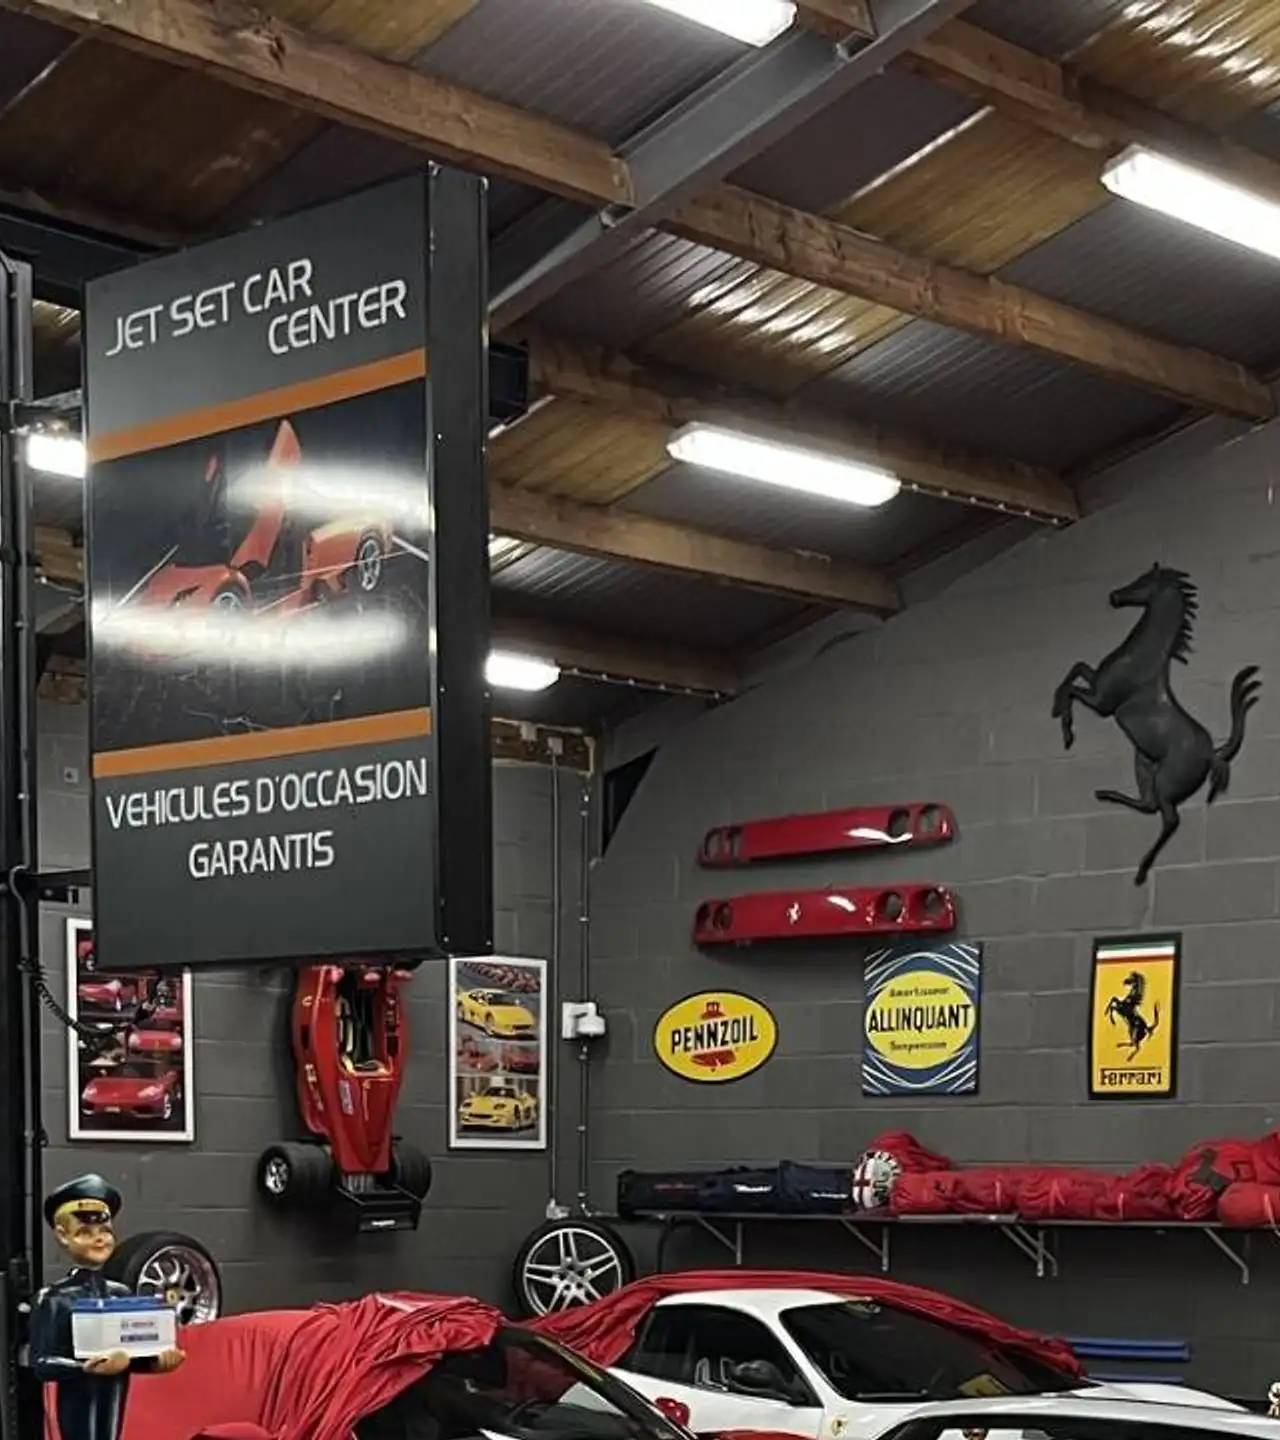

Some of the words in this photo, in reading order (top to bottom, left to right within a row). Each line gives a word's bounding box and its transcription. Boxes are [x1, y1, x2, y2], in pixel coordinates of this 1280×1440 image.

[105, 304, 164, 356] JET
[170, 281, 236, 337] SET
[243, 258, 313, 314] CAR
[267, 280, 407, 354] CENTER
[105, 779, 251, 829] VEHICULES
[256, 758, 427, 815] D'OCCASION
[188, 830, 335, 878] GARANTIS
[671, 1015, 758, 1055] PENNZOIL
[868, 1003, 972, 1033] ALLINQUANT
[1100, 1066, 1162, 1086] Ferrari
